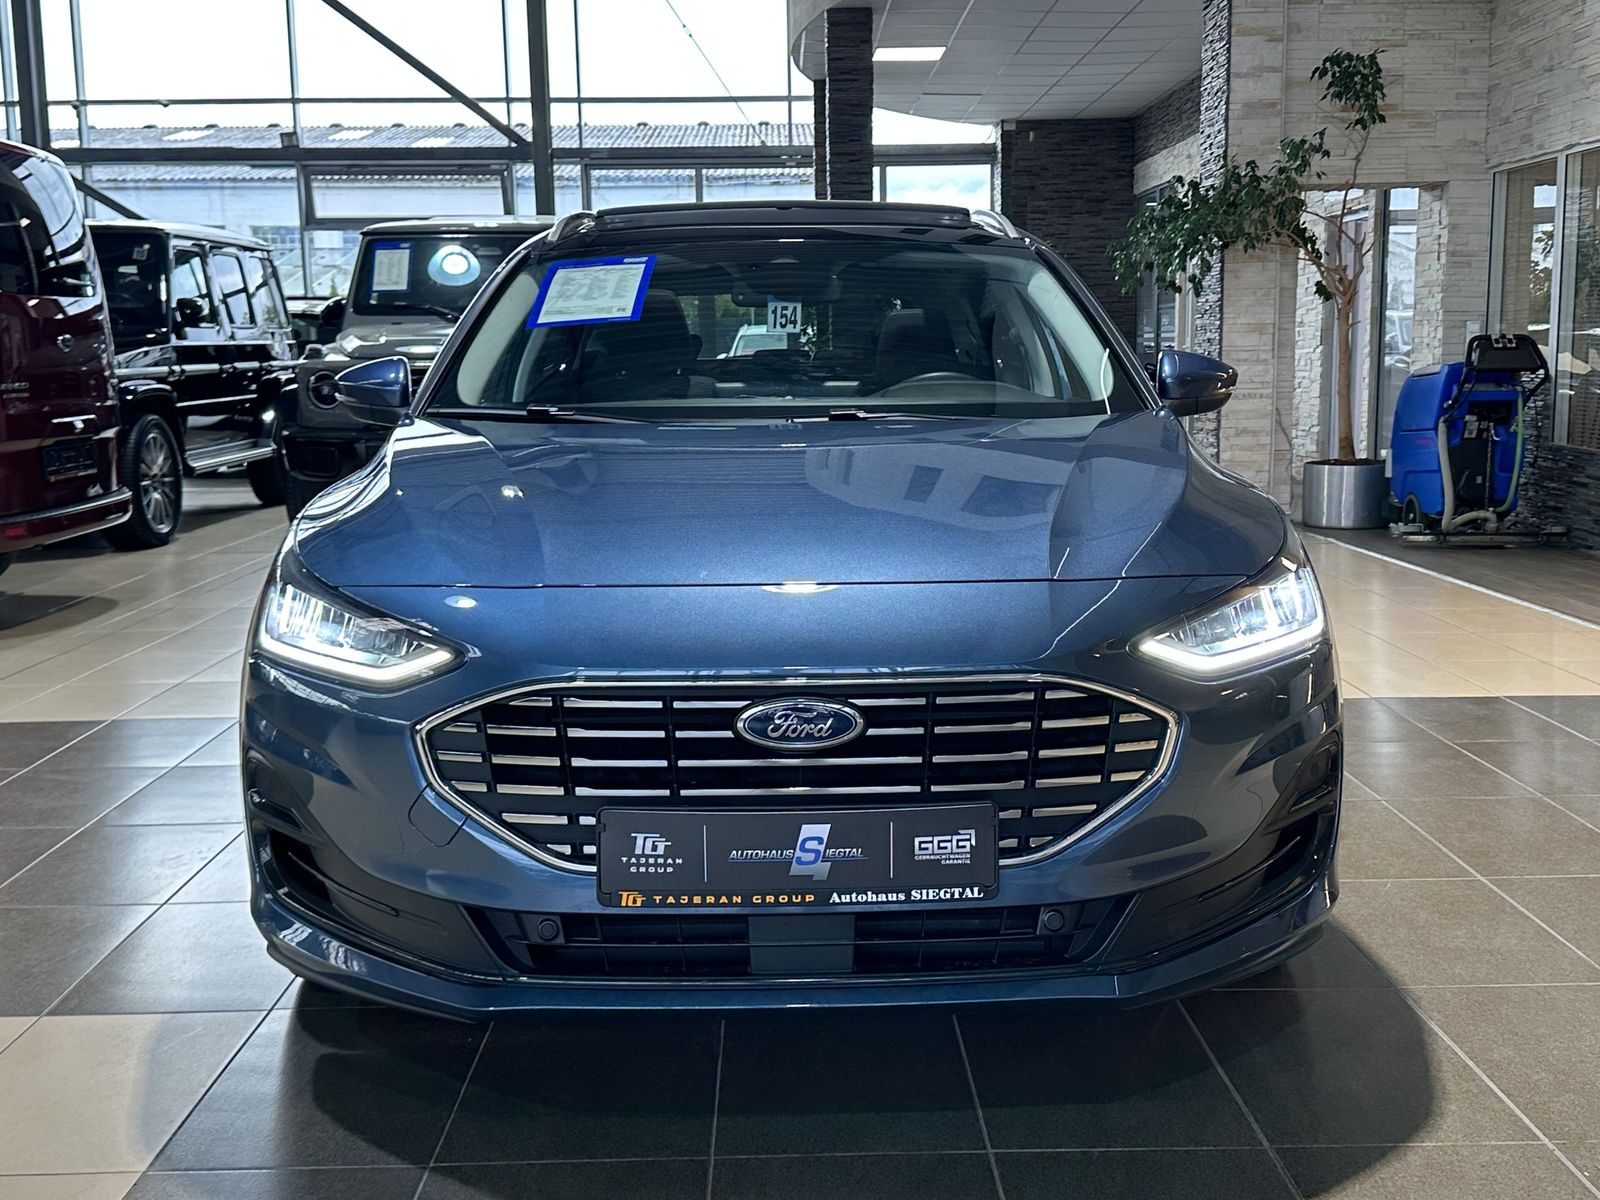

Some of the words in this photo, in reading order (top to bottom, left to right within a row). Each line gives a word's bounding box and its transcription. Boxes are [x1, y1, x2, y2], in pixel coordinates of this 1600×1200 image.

[771, 305, 798, 329] 154
[767, 710, 834, 738] Ford
[914, 834, 971, 855] GGG
[621, 856, 683, 865] TAJERAN
[728, 849, 794, 860] AUTOHAUS
[914, 853, 971, 861] GEBRAUCHTWAGEN
[653, 895, 742, 904] TAJERAN
[752, 894, 815, 904] GROUP
[829, 891, 906, 903] Autohaus
[910, 886, 984, 901] SIEGTAL
